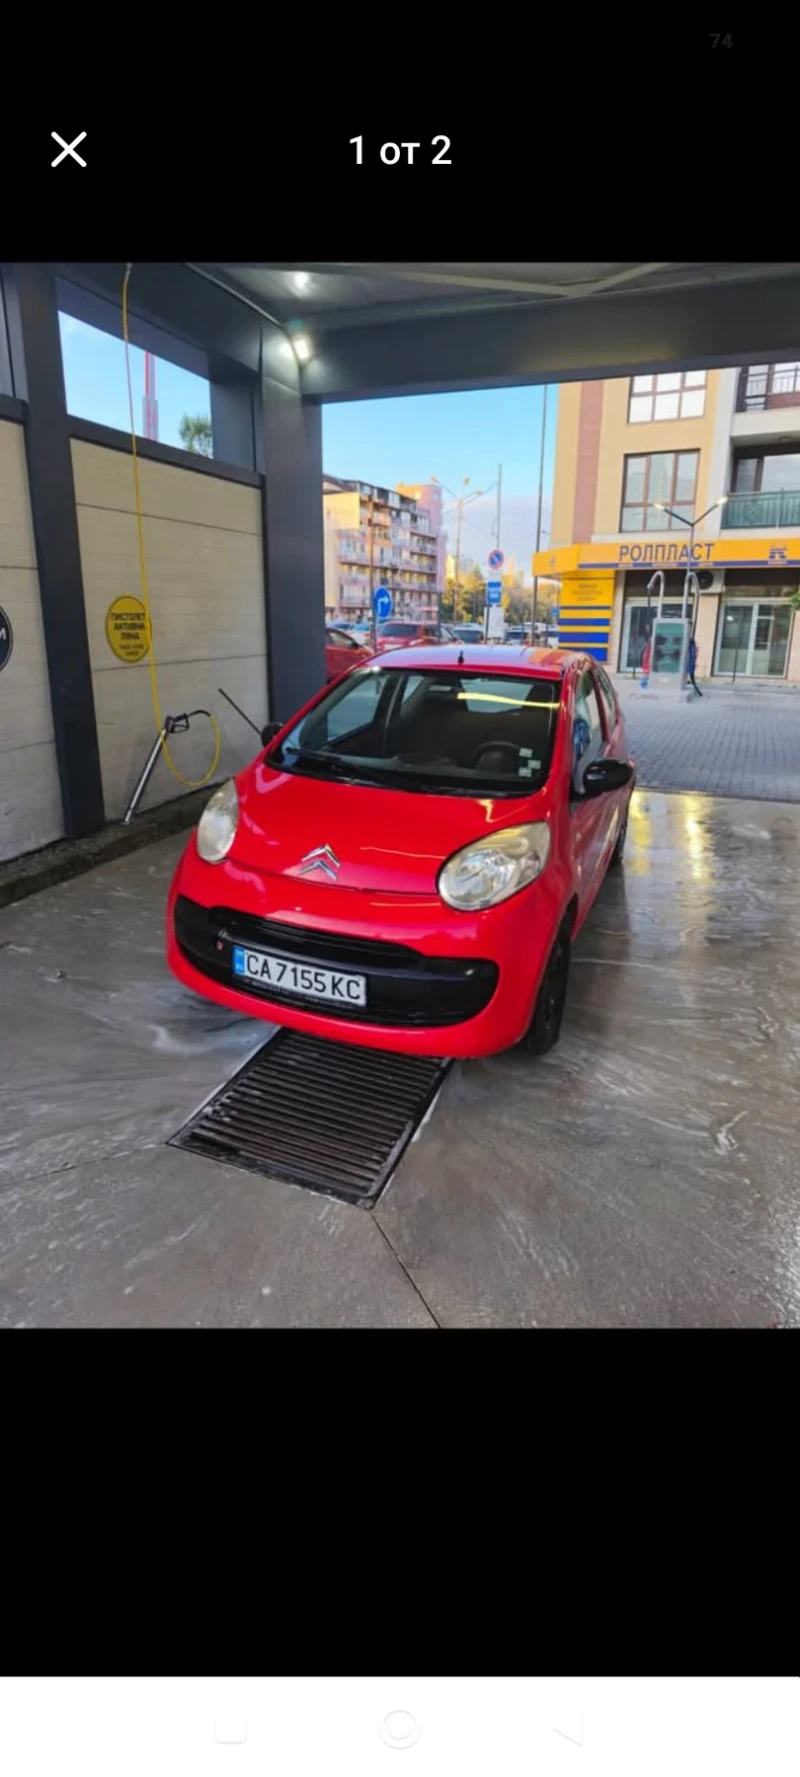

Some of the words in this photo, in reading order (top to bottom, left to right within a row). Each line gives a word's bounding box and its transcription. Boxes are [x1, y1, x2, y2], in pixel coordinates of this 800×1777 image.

[619, 543, 715, 562] РОЛПЛАСТ
[246, 954, 272, 982] CA
[276, 962, 327, 994] 7155
[331, 974, 361, 1001] KC
